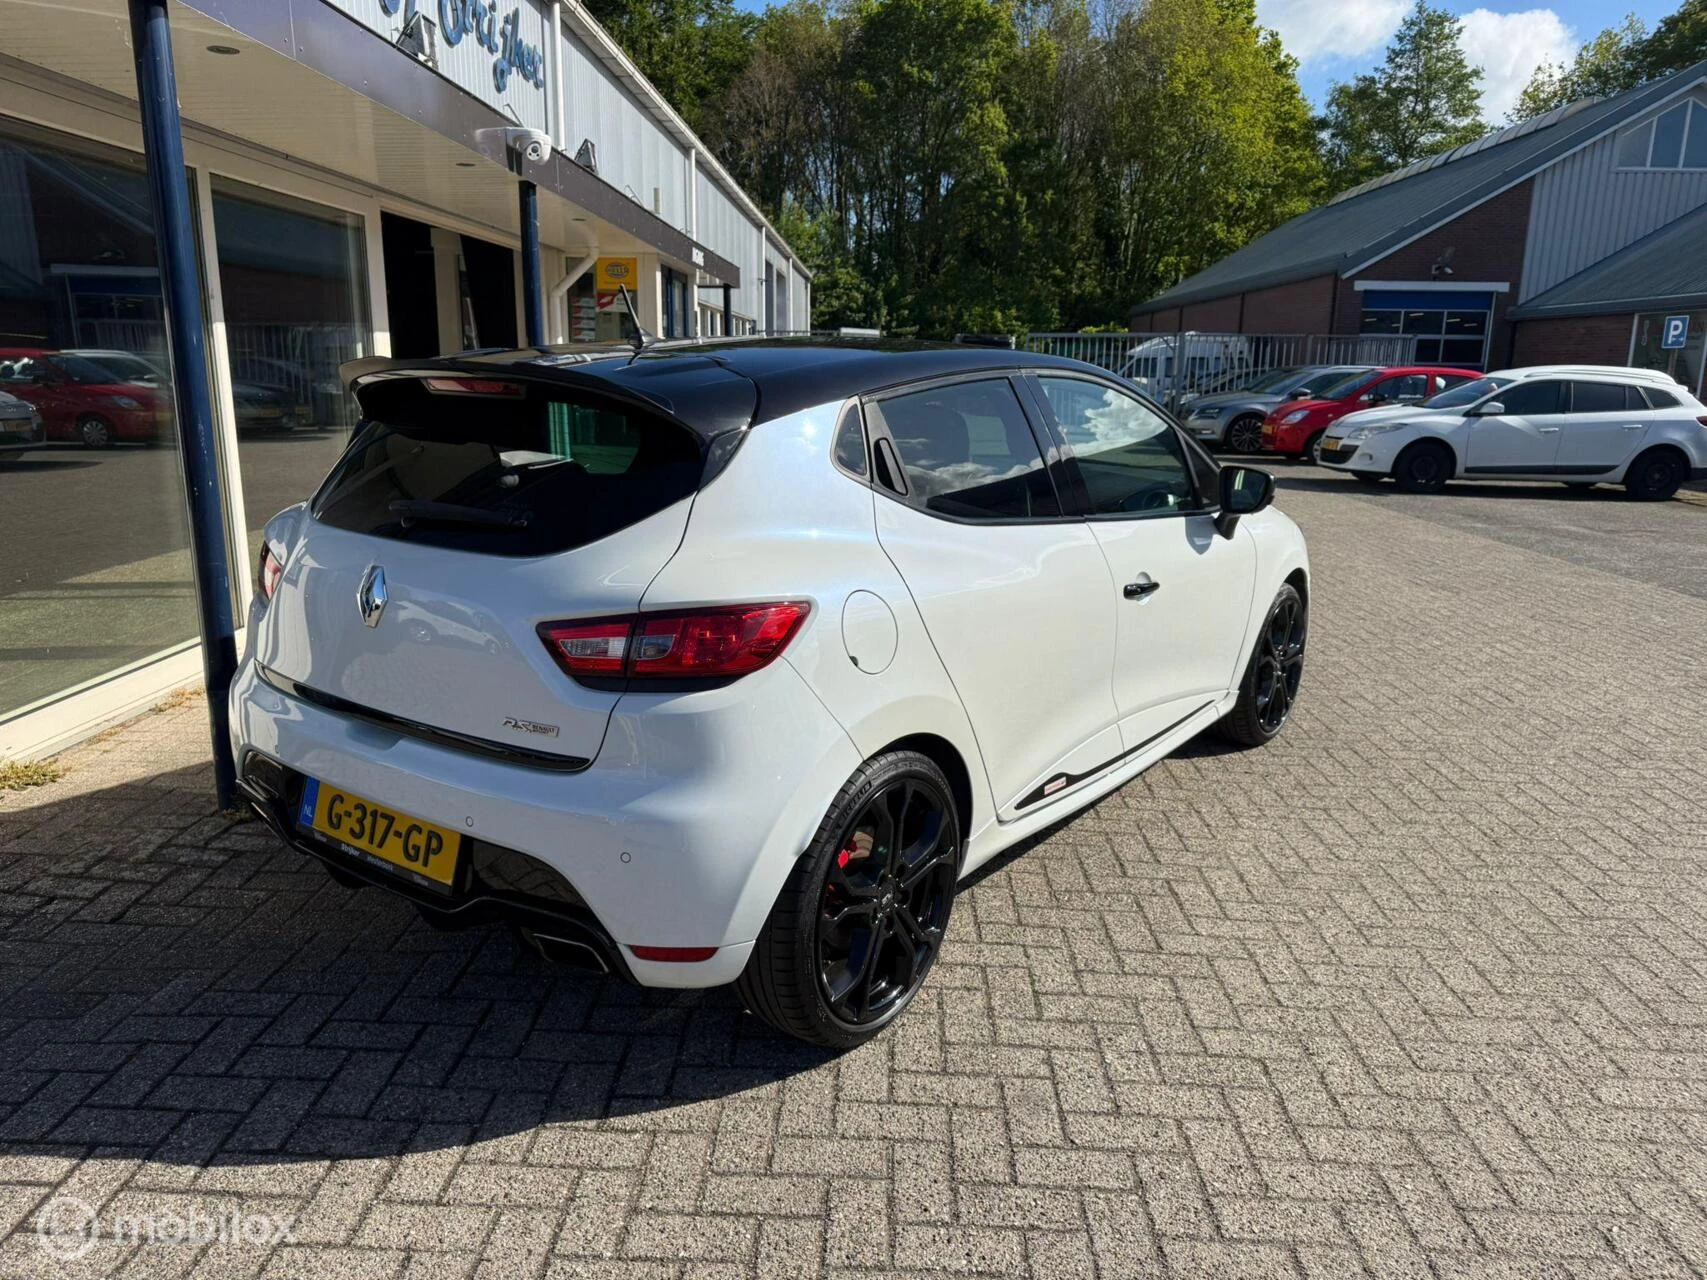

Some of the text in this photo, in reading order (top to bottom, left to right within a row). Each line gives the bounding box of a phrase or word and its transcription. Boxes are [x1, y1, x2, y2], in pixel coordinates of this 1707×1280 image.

[1667, 320, 1683, 344] P
[303, 804, 313, 819] NL
[327, 793, 444, 868] G-317-GP
